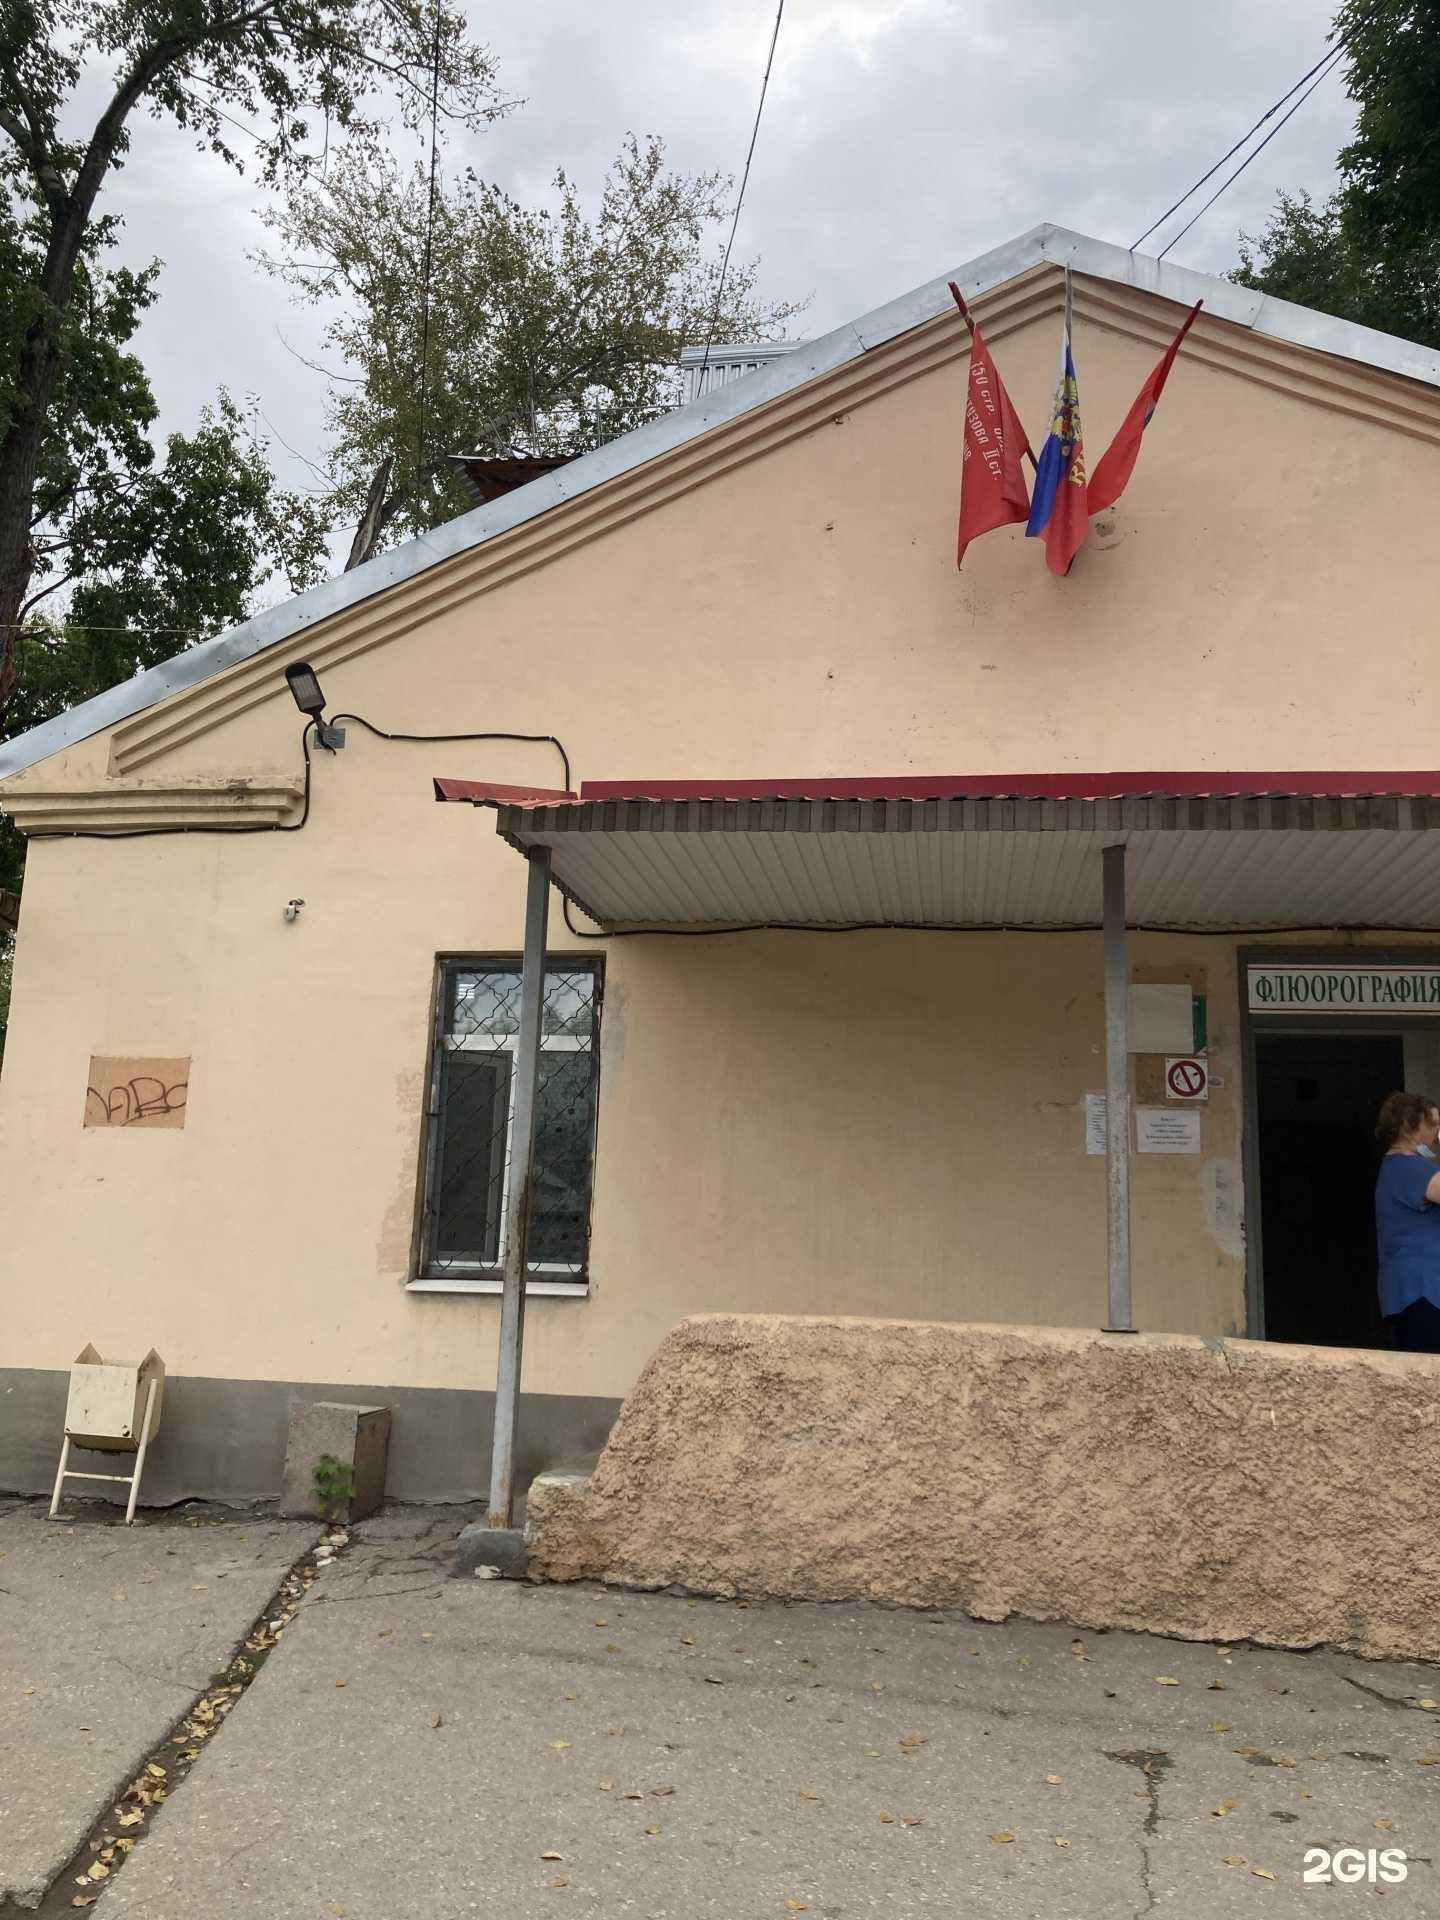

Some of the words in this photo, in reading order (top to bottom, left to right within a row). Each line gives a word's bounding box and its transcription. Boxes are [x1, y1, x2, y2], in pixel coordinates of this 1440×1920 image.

[970, 361, 988, 385] 150
[967, 400, 989, 445] ТУЗОВА
[1256, 974, 1440, 1003] ФЛЮОРОГРАФИЯ
